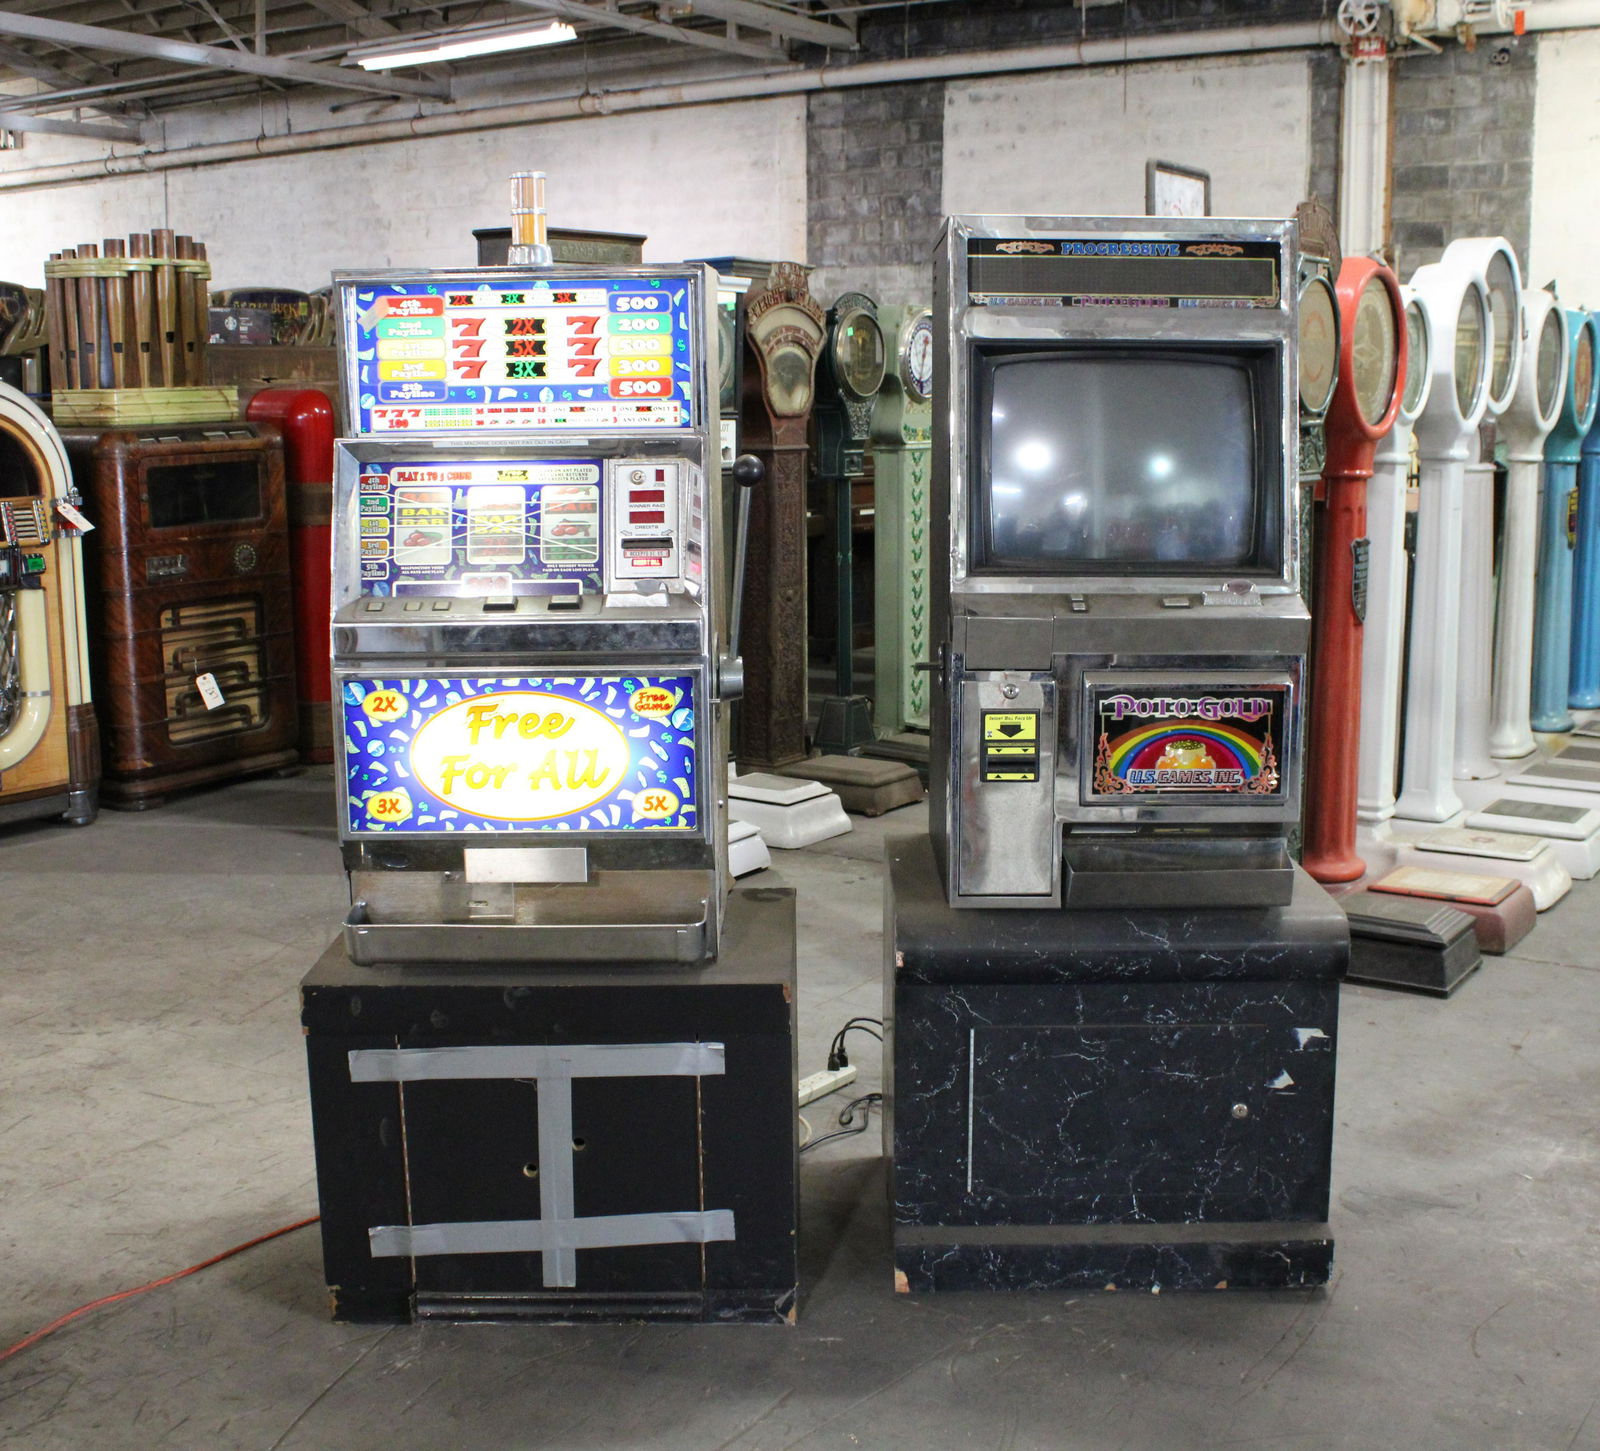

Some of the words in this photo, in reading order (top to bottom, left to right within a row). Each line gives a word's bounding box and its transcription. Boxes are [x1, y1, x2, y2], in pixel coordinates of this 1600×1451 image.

[1060, 242, 1180, 256] PROGRESSIVE
[400, 299, 421, 308] 4th
[453, 295, 468, 305] 2X
[505, 294, 519, 304] 3X
[616, 296, 658, 311] 500
[388, 306, 434, 316] Payline
[452, 318, 486, 336] 7
[512, 317, 536, 335] 2X
[566, 316, 600, 334] 7
[617, 318, 660, 331] 200
[388, 328, 433, 337] Payline
[452, 339, 487, 358] 7
[513, 339, 537, 357] 5X
[567, 337, 603, 355] 7
[453, 360, 487, 379] 7
[513, 360, 537, 378] 3X
[567, 358, 602, 377] 7
[618, 359, 660, 374] 300
[391, 370, 436, 378] Payline
[402, 383, 423, 391] 5th
[619, 380, 661, 396] 500
[390, 390, 435, 399] Payline
[397, 472, 419, 481] PLAY
[426, 472, 438, 481] TO
[361, 483, 386, 491] Payline
[360, 504, 386, 513] Payline
[360, 526, 386, 534] Payline
[360, 548, 386, 556] Payline
[638, 692, 668, 702] Free
[372, 696, 398, 713] 2X
[634, 700, 673, 712] Game
[1198, 696, 1268, 721] GOLD
[465, 703, 576, 746] Free
[440, 753, 519, 796] For
[528, 748, 611, 791] All
[1129, 770, 1156, 784] U.S.
[1213, 770, 1241, 784] INC.
[376, 798, 402, 815] 3X
[643, 796, 668, 812] 5X
